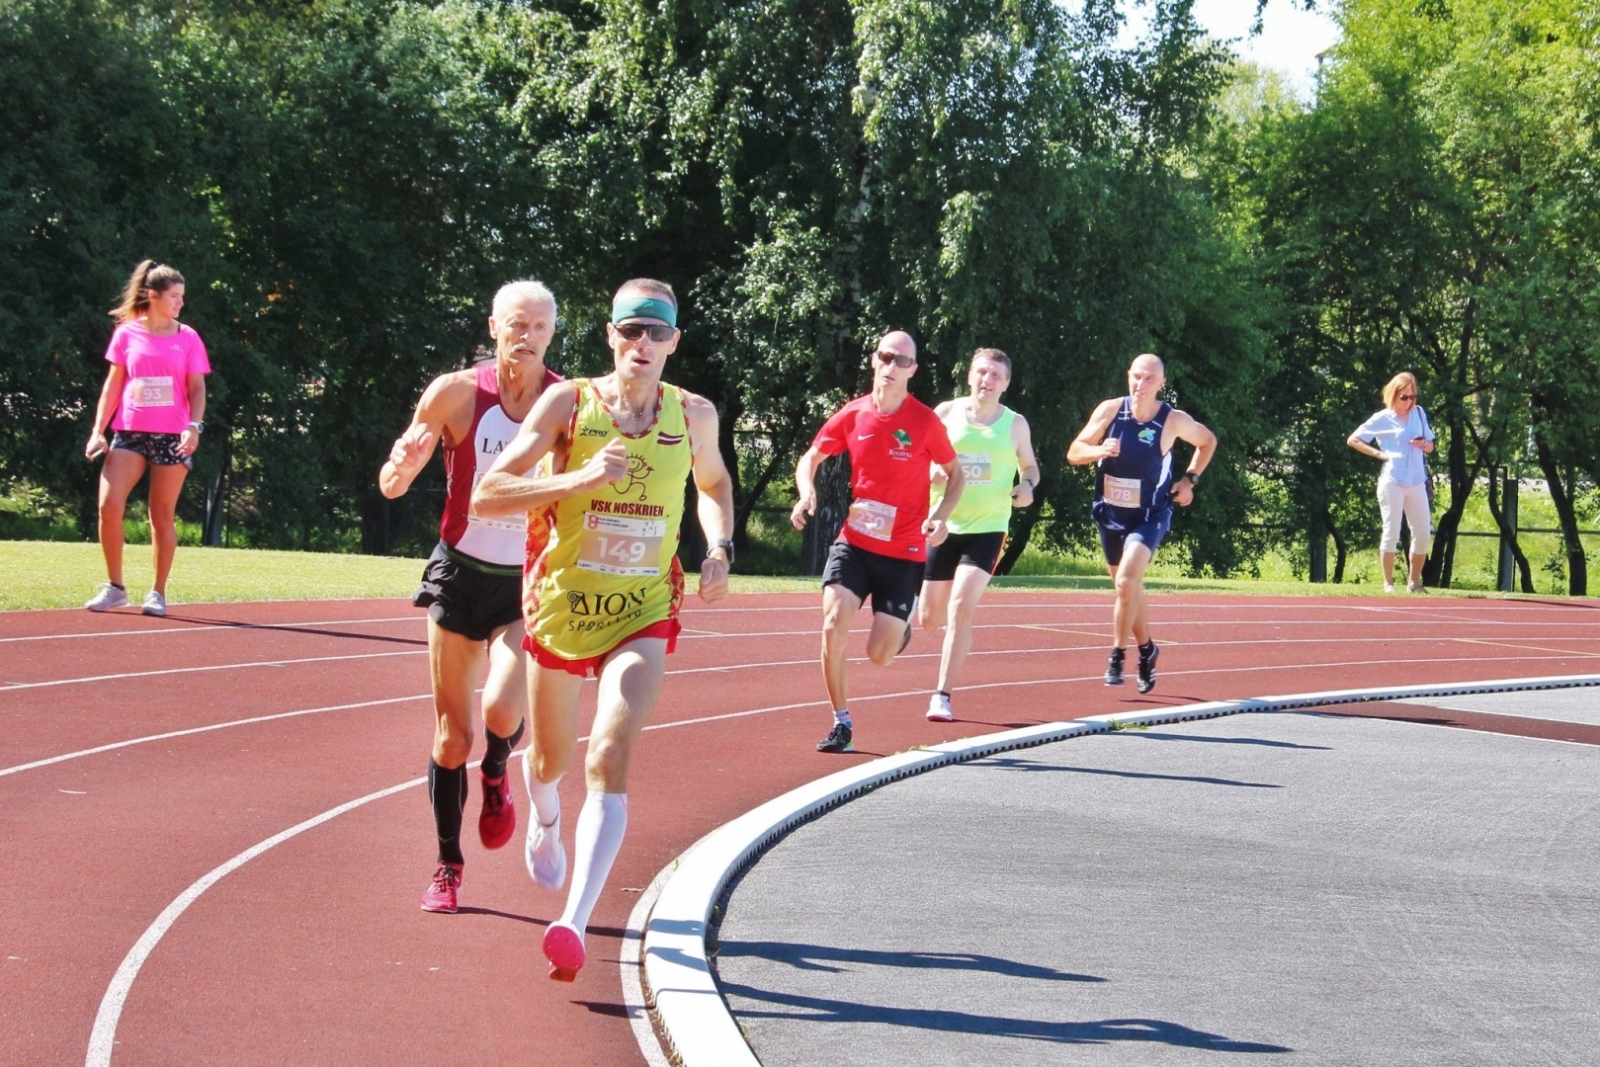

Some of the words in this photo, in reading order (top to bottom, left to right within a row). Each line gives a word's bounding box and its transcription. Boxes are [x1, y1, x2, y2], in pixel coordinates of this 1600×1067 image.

[143, 387, 161, 400] 93
[482, 437, 508, 455] LA
[961, 465, 982, 478] 50
[1109, 487, 1132, 501] 178
[590, 499, 613, 514] VSK
[613, 502, 665, 517] NOSKRIEN
[855, 510, 885, 531] 230
[597, 536, 646, 563] 149
